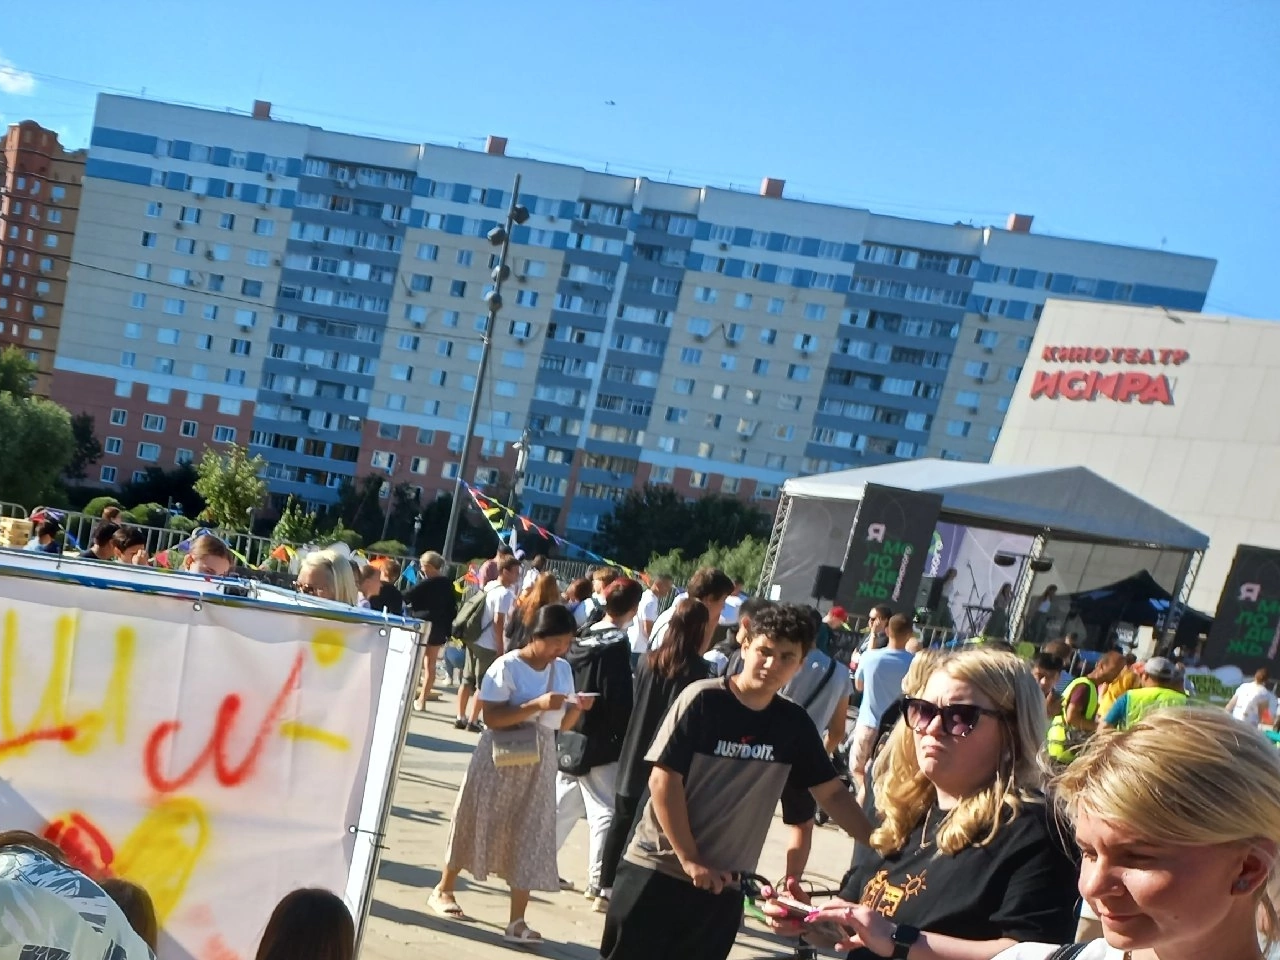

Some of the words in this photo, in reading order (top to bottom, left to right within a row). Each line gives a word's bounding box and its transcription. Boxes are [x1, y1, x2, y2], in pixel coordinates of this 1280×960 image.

[1041, 344, 1190, 366] КИНОТЕАТР
[1029, 370, 1177, 406] ИСКРА
[867, 523, 886, 543] Я
[1239, 582, 1261, 602] Я
[740, 743, 761, 759] DO
